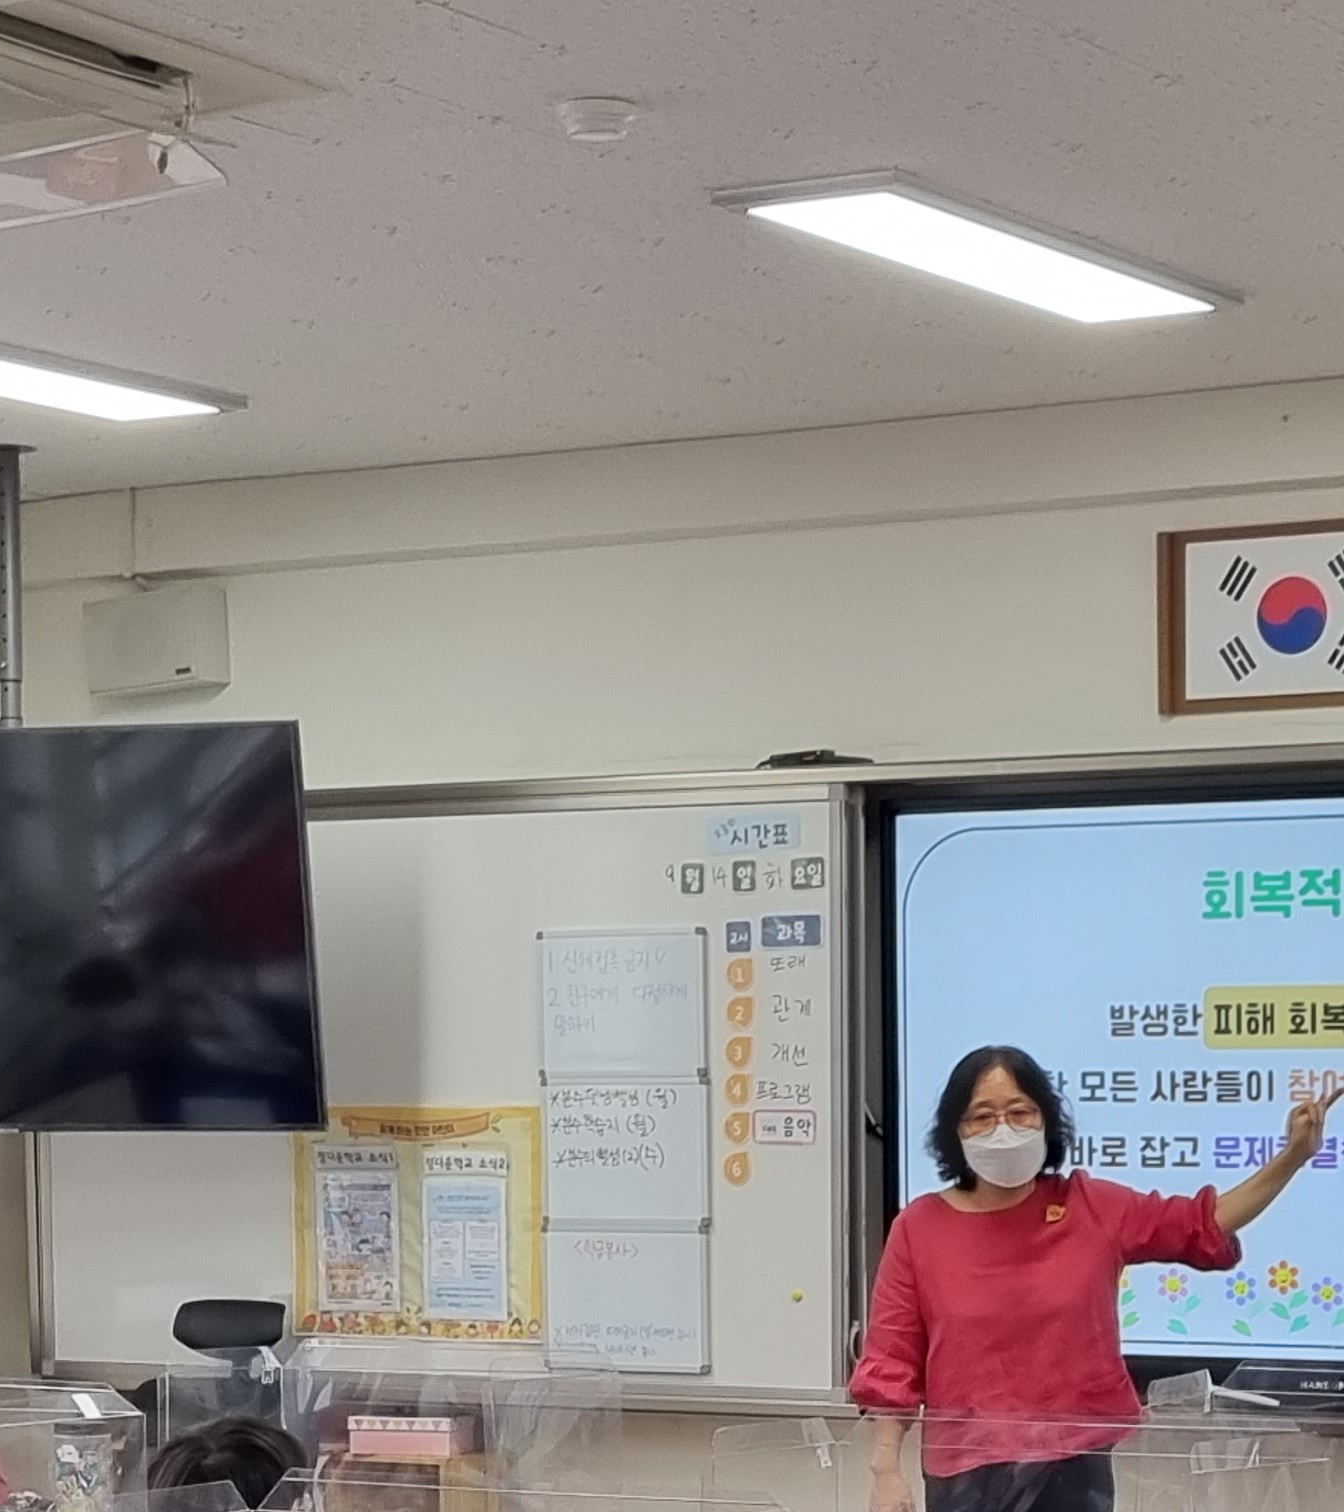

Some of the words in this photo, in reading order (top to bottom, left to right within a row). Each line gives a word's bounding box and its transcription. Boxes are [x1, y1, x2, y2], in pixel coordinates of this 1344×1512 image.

[730, 823, 789, 849] 시간표
[665, 864, 675, 882] 9
[712, 866, 728, 888] 14
[736, 865, 752, 890] 일
[763, 861, 783, 890] 화
[793, 863, 823, 887] 요일
[1202, 868, 1342, 919] 회복적
[776, 921, 807, 944] 과목
[770, 955, 807, 972] 또래
[735, 1007, 745, 1022] 2
[1109, 1003, 1204, 1037] 발생한
[1213, 1002, 1276, 1035] 피해
[771, 1043, 810, 1067] 개선
[756, 1080, 812, 1106] 프로그램
[1079, 1069, 1139, 1103] 모든
[1150, 1068, 1274, 1102] 사람들이
[783, 1116, 812, 1138] 음악
[1139, 1136, 1201, 1168] 잡고
